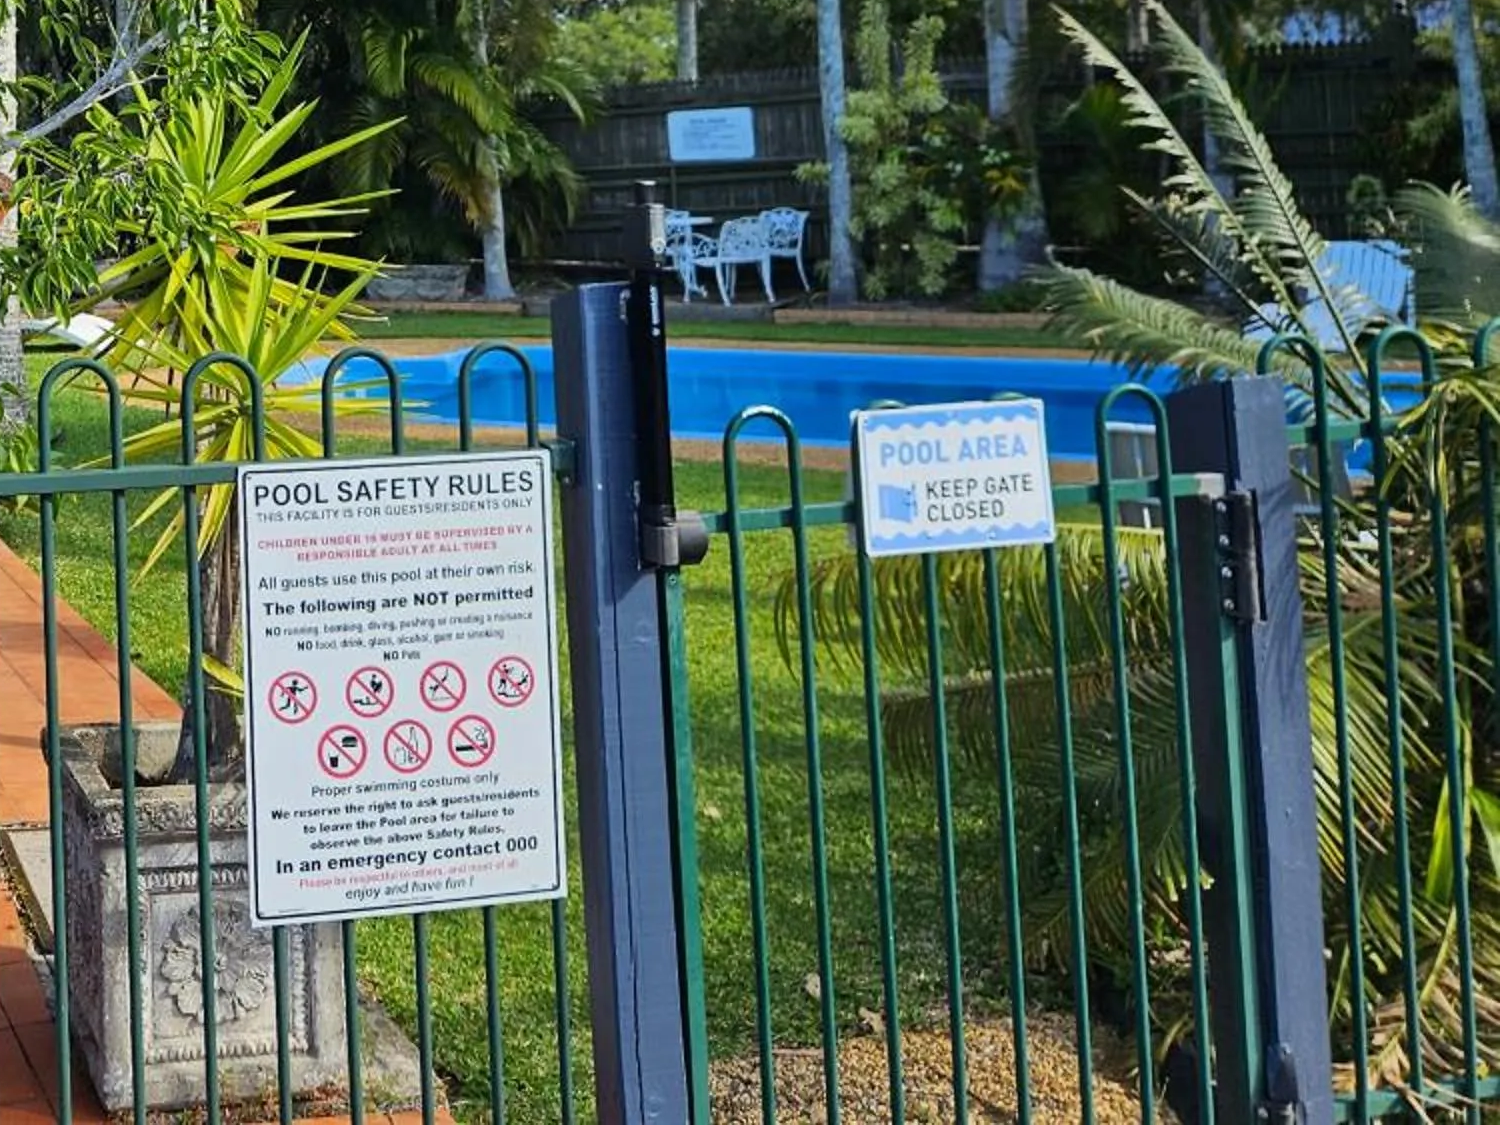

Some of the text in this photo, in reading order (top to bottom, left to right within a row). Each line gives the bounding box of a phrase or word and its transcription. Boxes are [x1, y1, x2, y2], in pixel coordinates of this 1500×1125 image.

[880, 435, 1028, 467] POOL AREA
[255, 471, 533, 507] POOL SAFETY RULES
[925, 474, 1034, 500] KEEP GATE
[257, 497, 533, 523] THIS FACILITY IS FOR GUESTS/RESIDENTS ONLY
[927, 500, 1005, 523] CLOSED
[258, 537, 317, 550] CHILDREN
[321, 535, 360, 546] UNDER
[380, 531, 413, 542] MUST
[415, 530, 430, 540] BE
[434, 527, 504, 539] SUPERVISED
[507, 525, 522, 535] BY
[525, 525, 533, 534] A
[297, 541, 497, 562] RESPONSIBLE ADULT AT ALL TIMES
[258, 577, 277, 590] All
[281, 575, 329, 592] guests
[332, 574, 357, 586] use
[361, 572, 387, 584] this
[391, 568, 421, 584] pool
[425, 567, 439, 579] at
[441, 564, 473, 579] their
[476, 565, 505, 576] own
[263, 585, 533, 616] The following are NOT permitted
[265, 627, 281, 638] NO
[400, 617, 435, 631] pushing
[297, 640, 313, 651] NO
[383, 650, 399, 661] NO
[311, 771, 499, 797] Proper swimming costume only
[271, 788, 540, 820] We reserve the right to ask guests/residents
[303, 807, 515, 834] to leave the Pool area for failure to
[310, 837, 360, 850] observe
[363, 835, 383, 846] the
[387, 833, 423, 844] above
[427, 827, 464, 839] Safety
[276, 836, 538, 874] In an emergency contact 000
[345, 887, 380, 901] enjoy
[384, 882, 409, 895] and
[411, 880, 443, 893] have
[445, 877, 465, 890] fun
